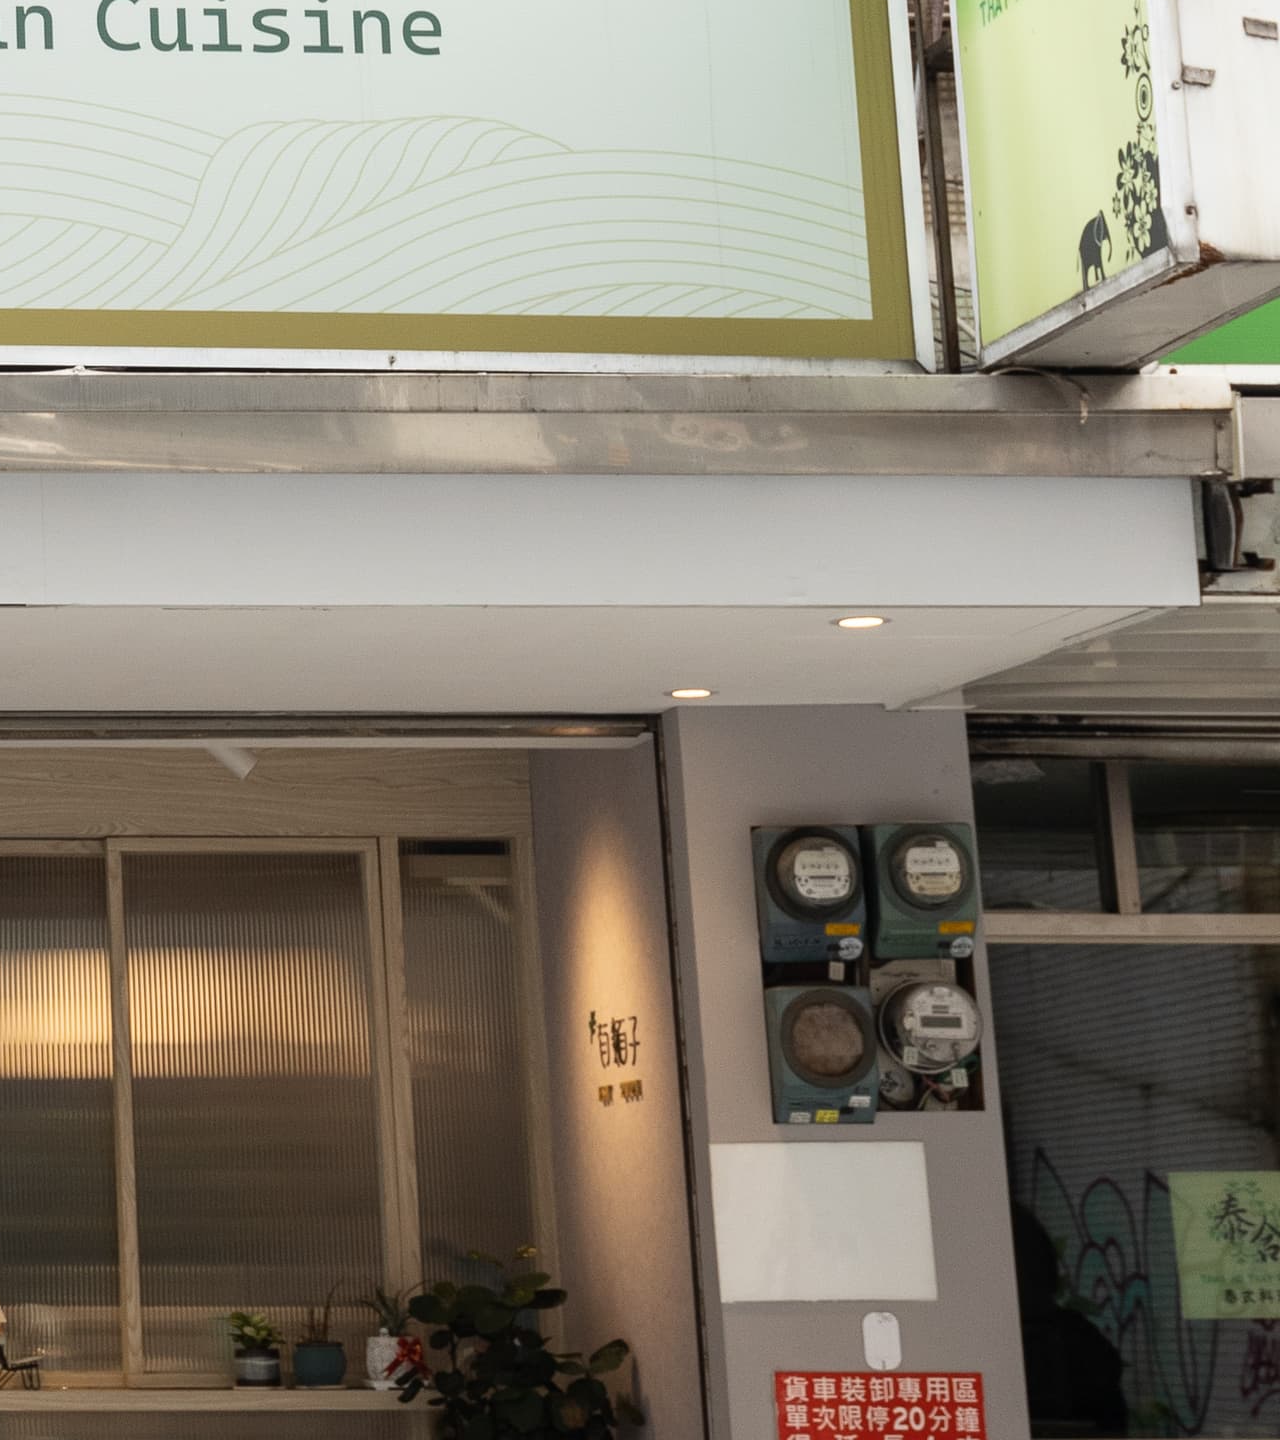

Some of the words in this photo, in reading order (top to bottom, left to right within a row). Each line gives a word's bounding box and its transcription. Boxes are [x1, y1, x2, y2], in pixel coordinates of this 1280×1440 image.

[784, 1376, 978, 1403] 貨車裝卸專用區
[785, 1405, 980, 1432] 單次限停20分鐘
